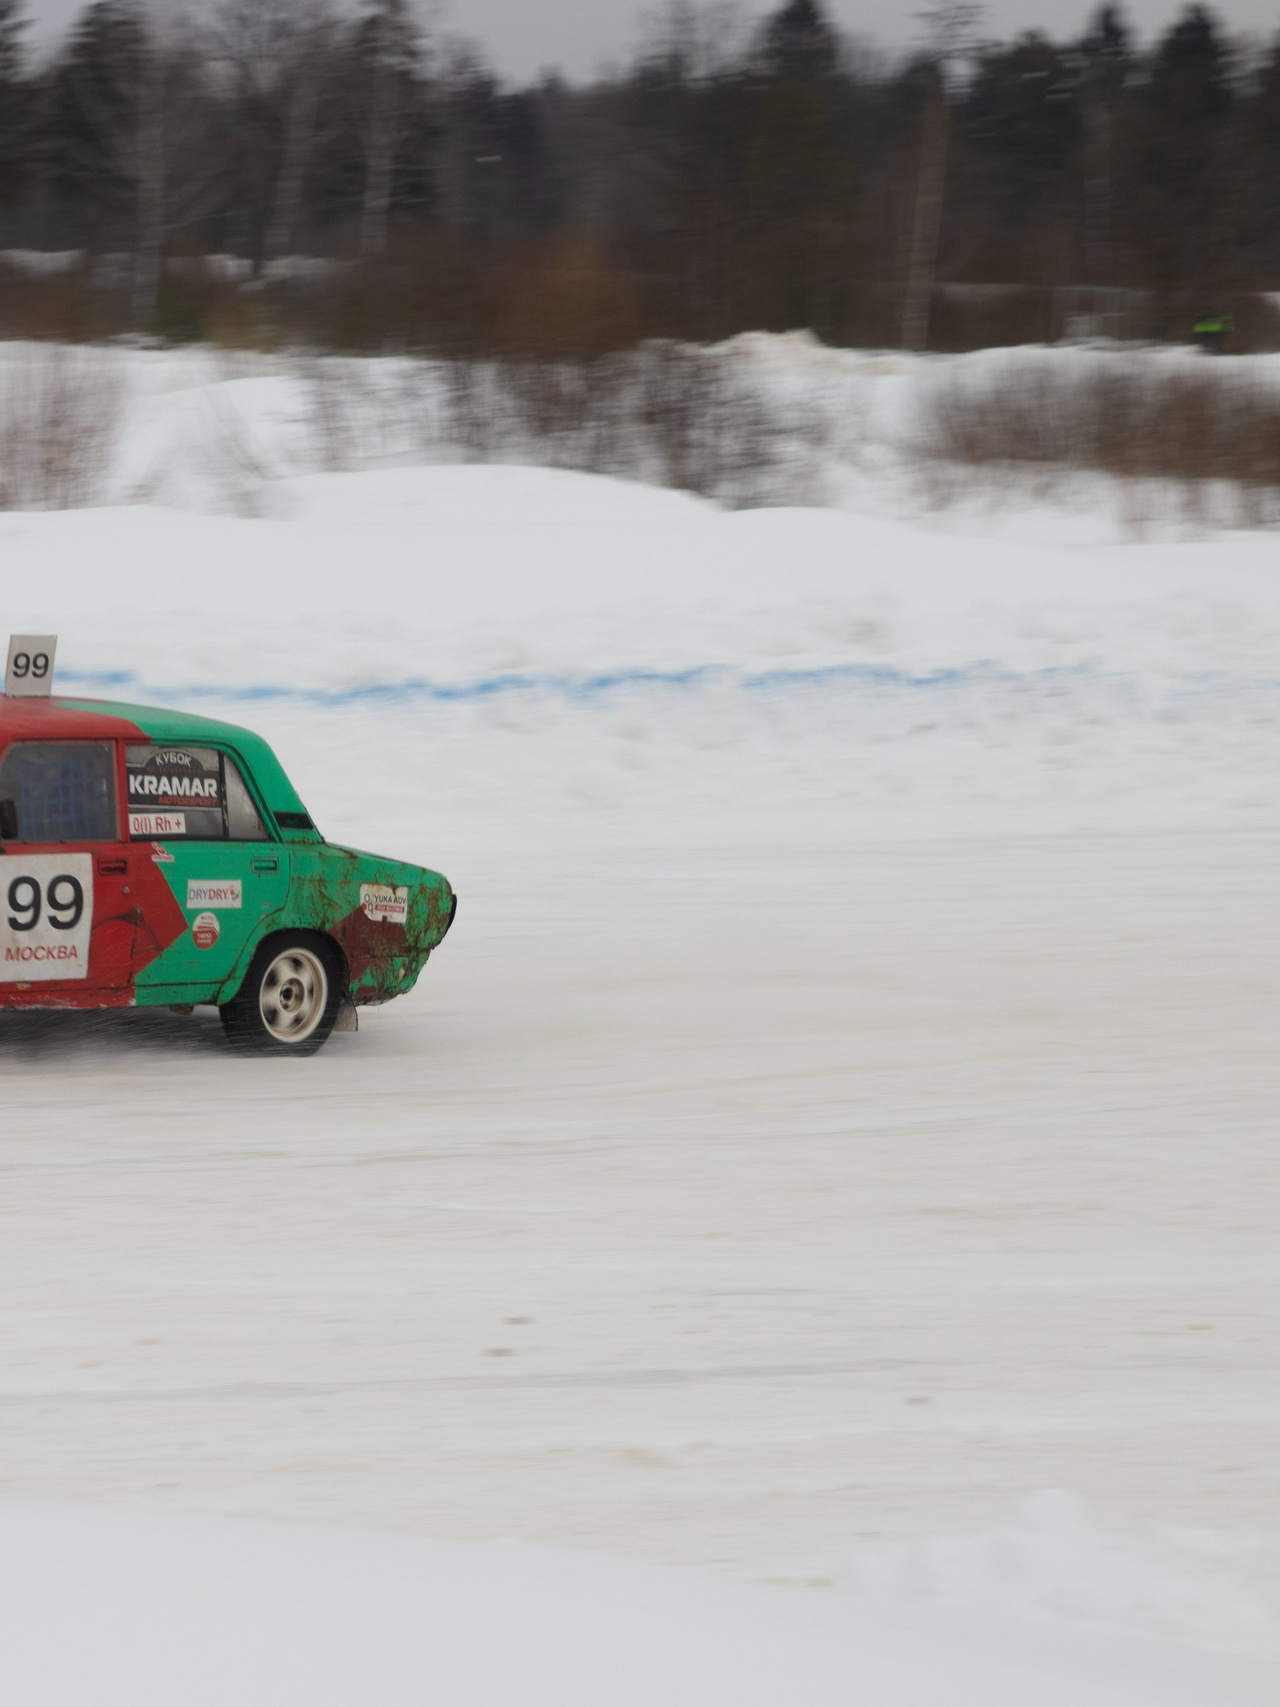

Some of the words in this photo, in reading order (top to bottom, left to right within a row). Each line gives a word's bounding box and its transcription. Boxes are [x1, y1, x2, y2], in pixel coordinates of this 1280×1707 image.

[12, 653, 49, 678] 99
[154, 751, 192, 767] КУБОК
[129, 774, 218, 798] KRAMAR
[155, 816, 172, 832] Rh
[188, 888, 229, 900] DRYDRY
[7, 874, 84, 932] 99
[5, 945, 78, 962] МОСКВА
